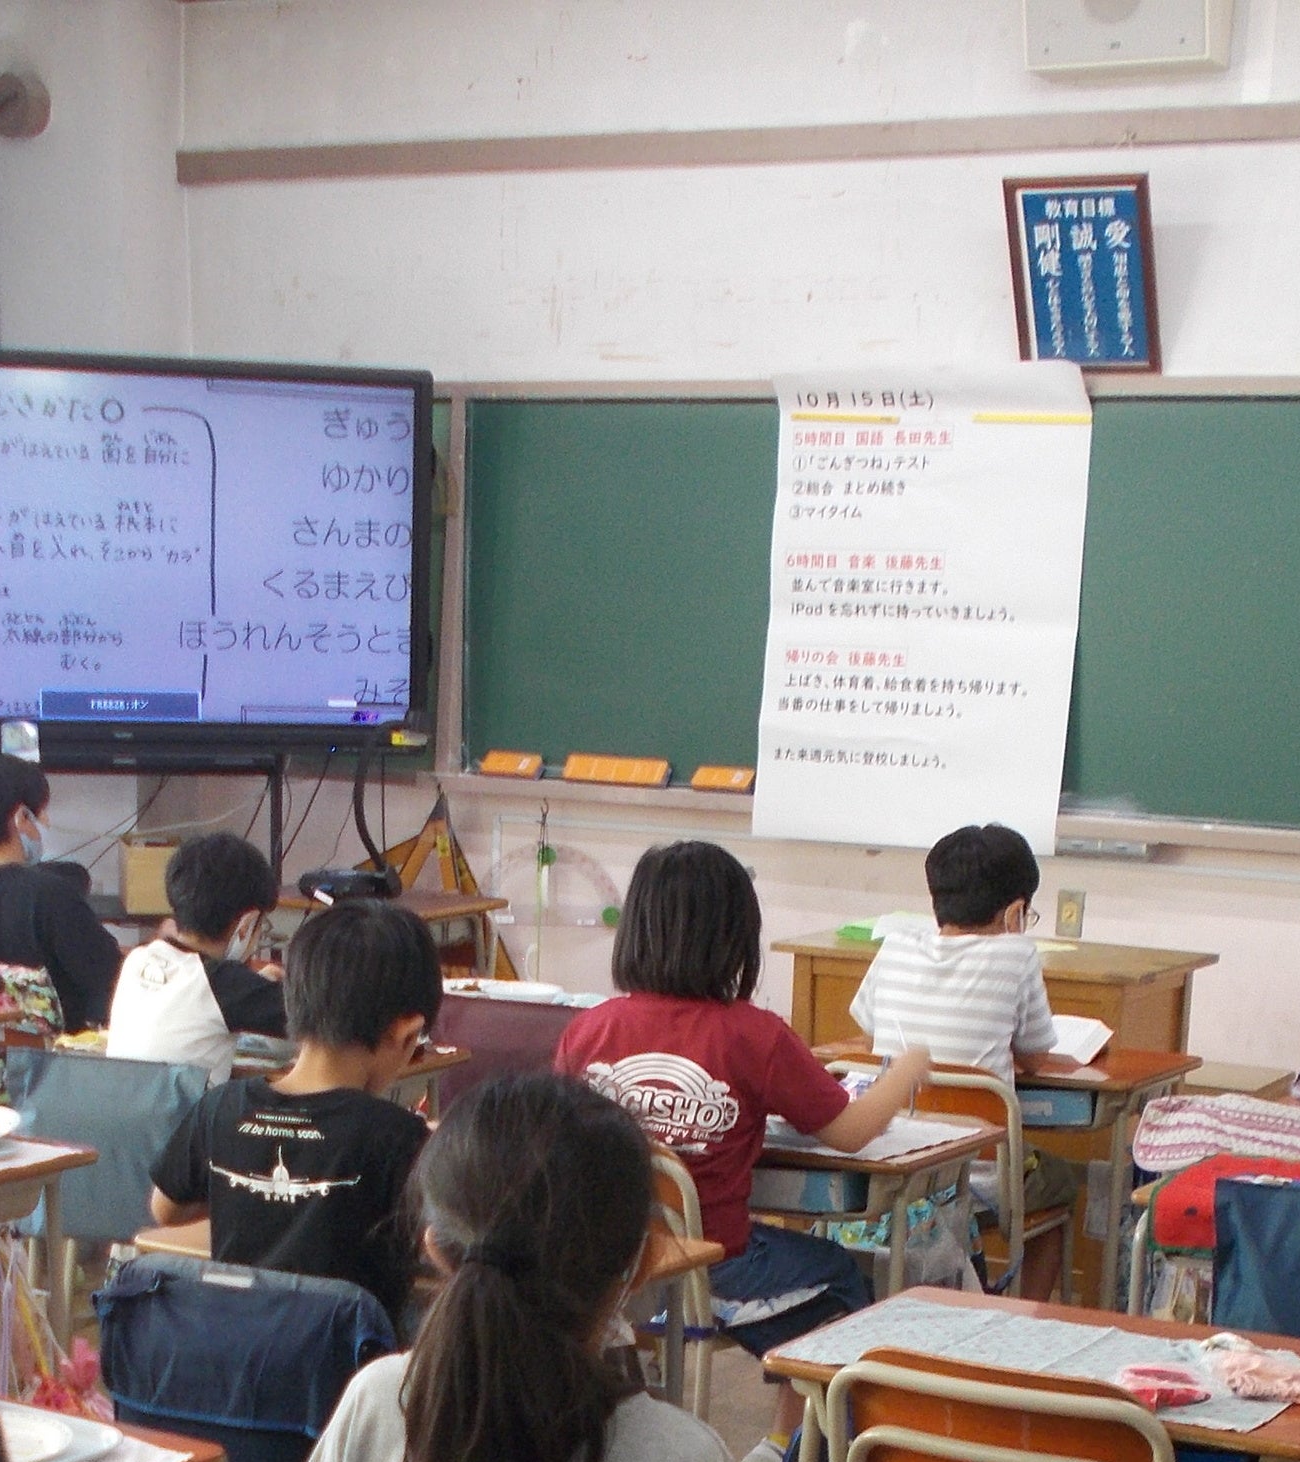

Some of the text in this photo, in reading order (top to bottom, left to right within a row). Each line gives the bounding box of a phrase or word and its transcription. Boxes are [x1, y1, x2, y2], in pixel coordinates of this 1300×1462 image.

[322, 408, 411, 442] ぎゅう
[794, 431, 952, 447] 5時間目 国語 長田先生
[321, 461, 411, 496] ゆかり
[291, 514, 413, 548] さんまの
[786, 554, 943, 571] 6時間目 音楽 後藤先生
[791, 577, 949, 596] 並んで音楽室に行きます。
[785, 650, 906, 667] 帰りの会 後藤先生
[778, 696, 962, 719] 当番の仕事をして帰りましょう。
[773, 747, 947, 770] また来週元気に登校しましょう。
